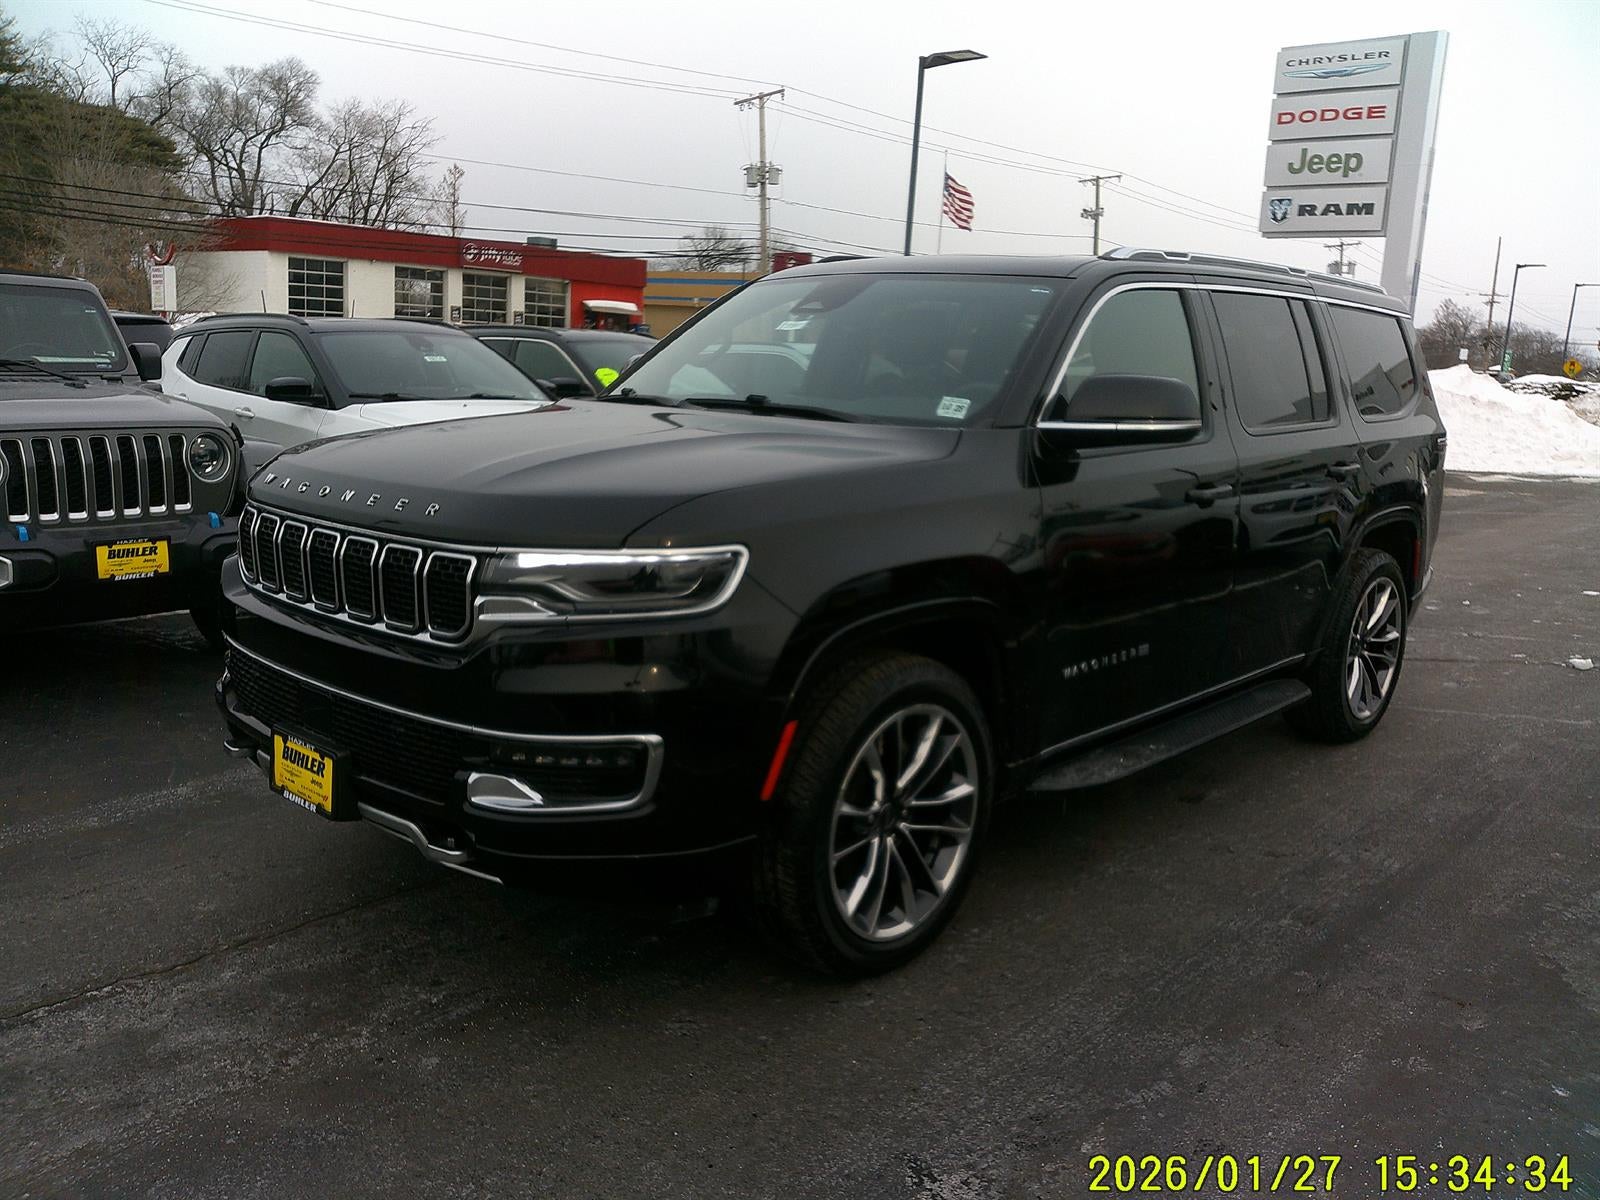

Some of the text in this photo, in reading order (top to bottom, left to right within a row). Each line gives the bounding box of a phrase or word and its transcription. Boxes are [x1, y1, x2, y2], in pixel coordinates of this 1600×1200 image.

[1286, 51, 1390, 67] CHRYSLER
[1277, 105, 1387, 125] DODGE
[1288, 148, 1363, 177] Jeep
[1297, 203, 1375, 217] RAM
[264, 473, 440, 516] WAGONEER
[107, 546, 158, 560] BUHLER
[114, 571, 155, 581] BUHLER
[288, 735, 315, 752] HAZLET
[282, 745, 326, 778] BUHLER
[283, 789, 317, 813] BUHLER
